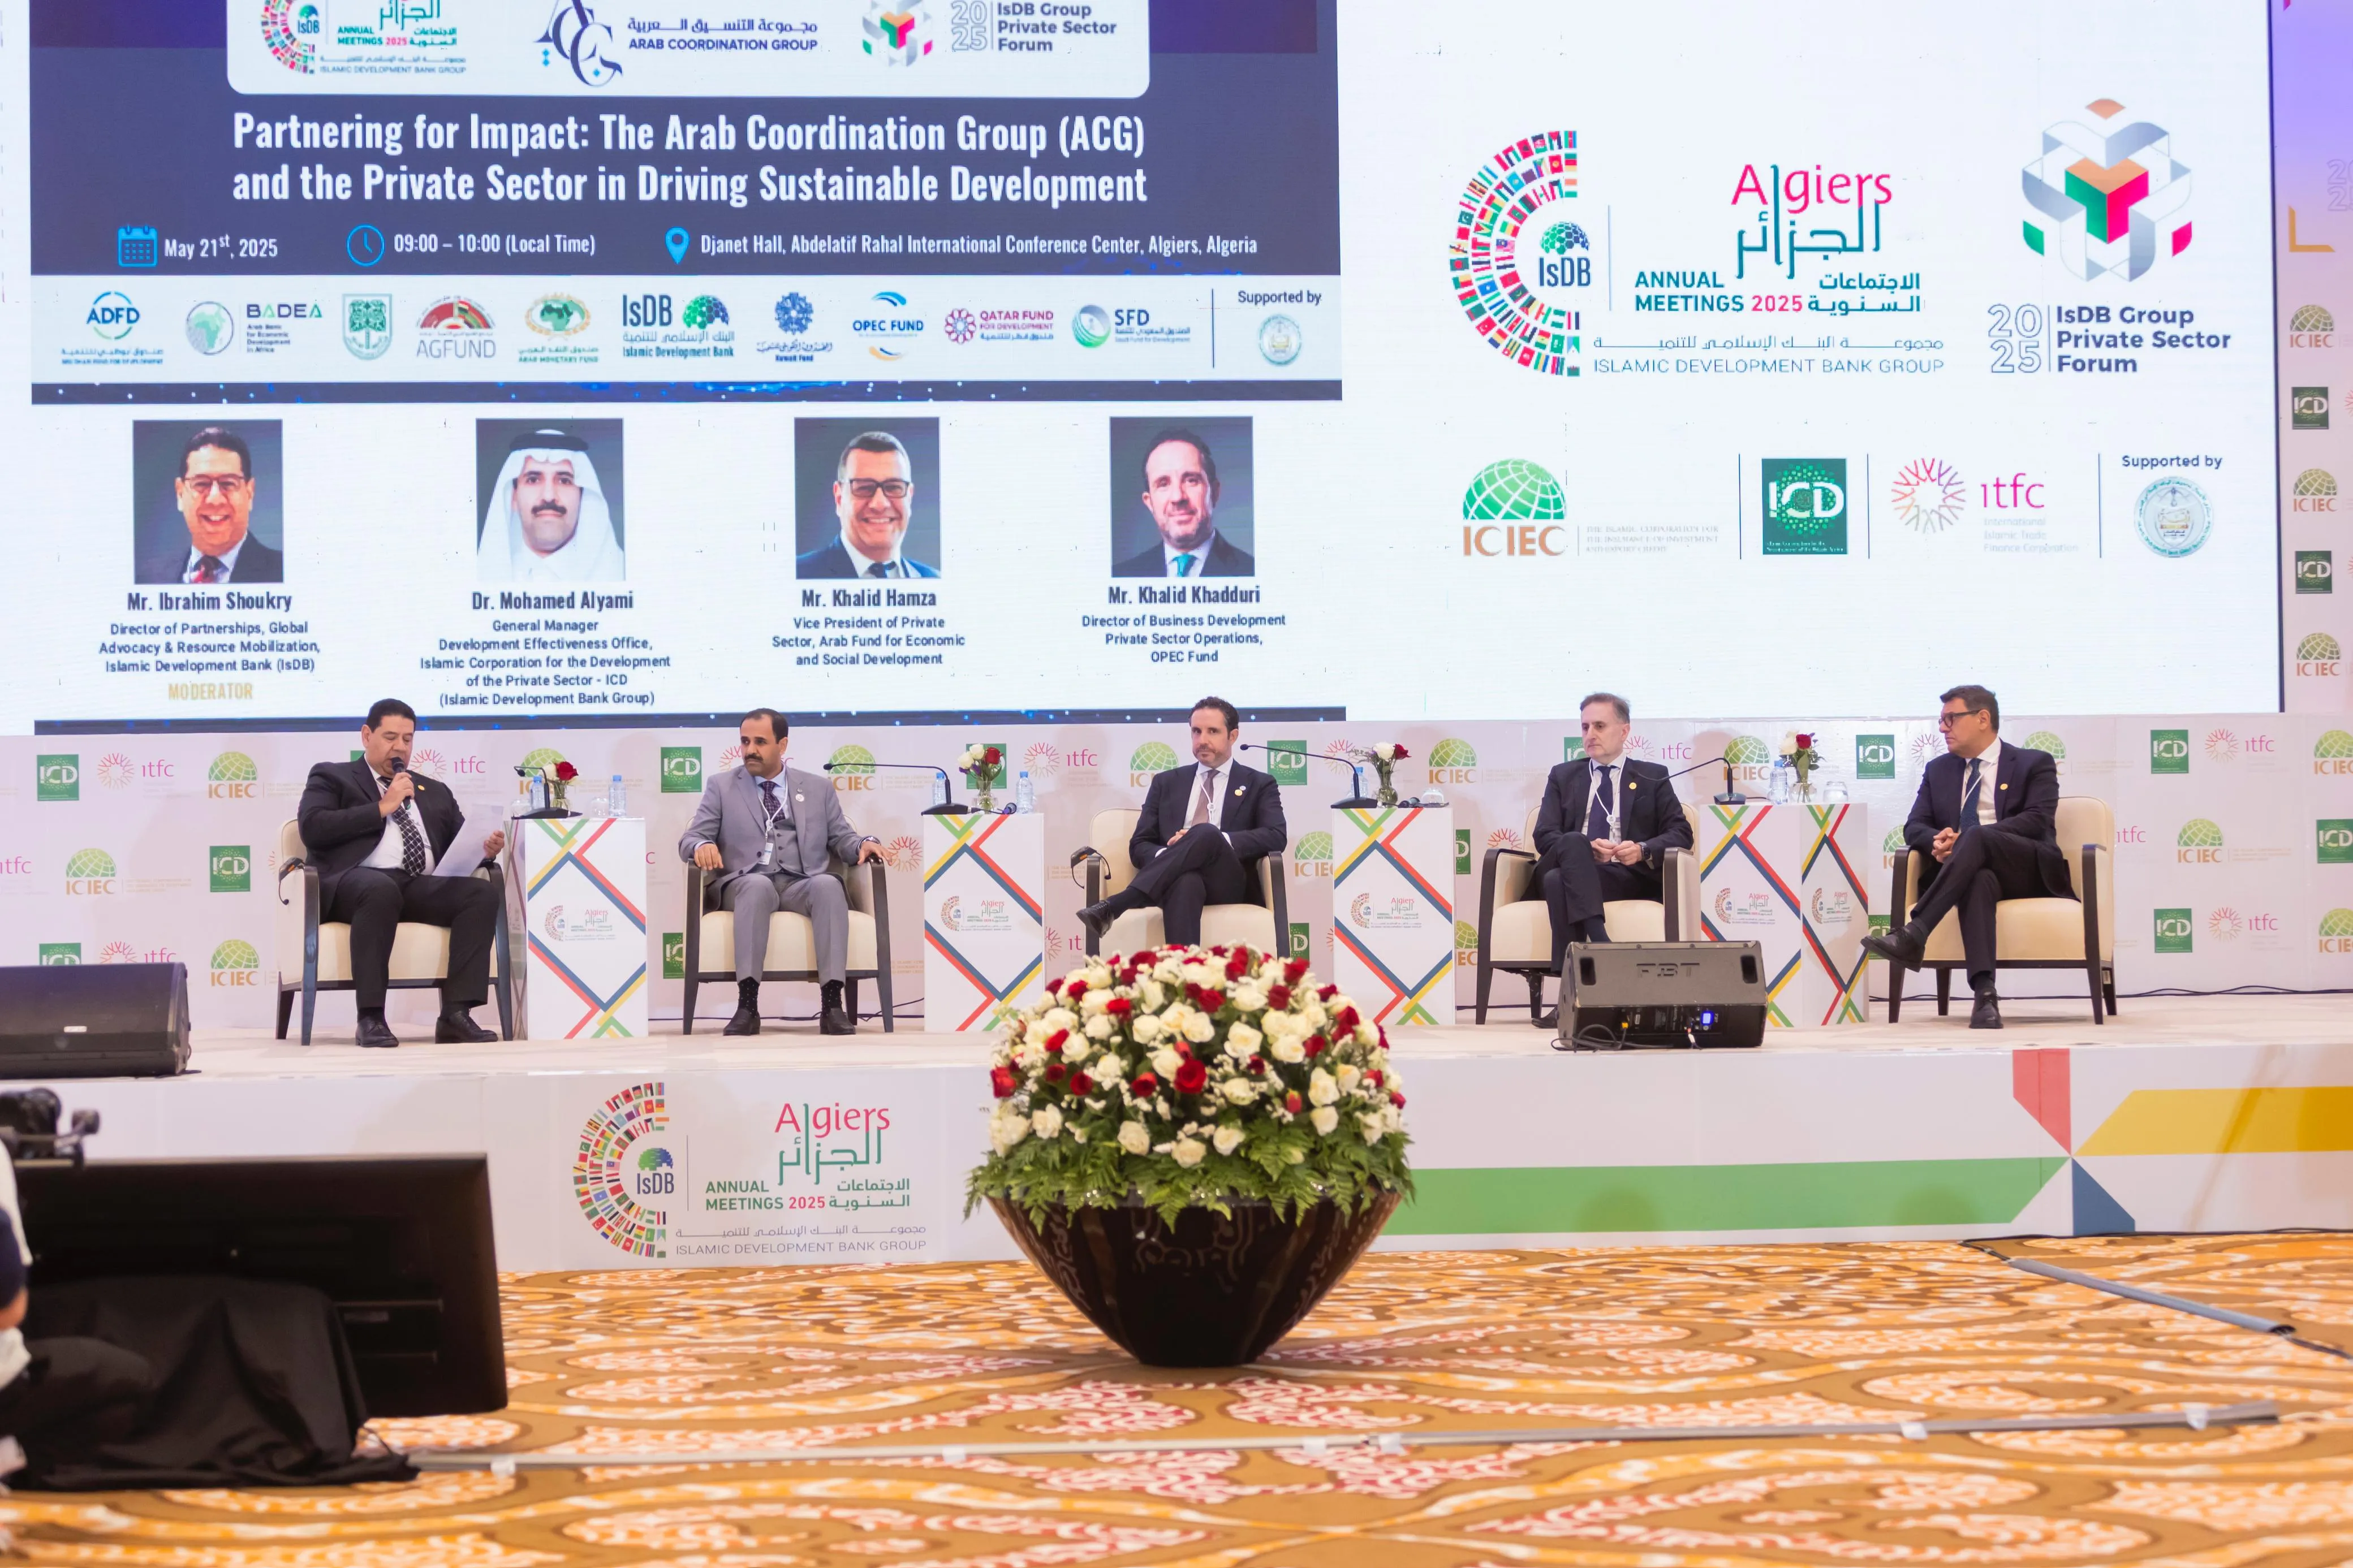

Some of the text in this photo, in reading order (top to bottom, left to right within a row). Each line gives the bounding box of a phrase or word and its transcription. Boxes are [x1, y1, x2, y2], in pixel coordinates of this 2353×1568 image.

[998, 2, 1092, 19] IsDB Group
[998, 19, 1117, 34] Private Sector
[630, 39, 818, 51] ARAB COORDINATION GROUP
[998, 38, 1053, 51] Forum
[234, 113, 1144, 158] Partnering for Impact: The Arab Coordination Group (ACG)
[233, 164, 1147, 209] and the Private Sector in Driving Sustainable Development
[1731, 165, 1891, 217] Algiers
[165, 239, 195, 260] May
[240, 239, 277, 257] 2025
[394, 234, 595, 256] 09:00 10:00 (Local Time)
[701, 235, 1257, 257] Djanet Hall, Abdelatif Rahal International Conference Center, Algiers, Algeria
[1540, 257, 1591, 287] IsDB
[1635, 271, 1724, 288] ANNUAL
[1820, 273, 1920, 290] الاجتماعات
[1238, 290, 1321, 306] Supported by
[1636, 295, 1802, 312] MEETINGS 2025
[1808, 295, 1920, 316] السنوية
[87, 308, 140, 324] ADFD
[247, 304, 322, 318] BADEA
[623, 295, 672, 326] IsDB
[980, 311, 1053, 321] QATAR FUND
[1115, 309, 1149, 326] SFD
[2057, 306, 2193, 329] IsDB Group
[853, 320, 924, 331] OPEC FUND
[1988, 304, 2042, 338] 20
[2058, 329, 2230, 348] Private Sector
[417, 340, 496, 358] AGFUND
[623, 346, 733, 359] Islamic Development Bank
[1990, 339, 2041, 373] 25
[1594, 359, 1943, 373] ISLAMIC DEVELOPMENT BANK GROUP
[2058, 355, 2137, 372] Forum
[2122, 455, 2222, 470] Supported by
[1981, 473, 2044, 508] itfc
[1769, 481, 1844, 518] ICD
[128, 591, 292, 612] Mr. Ibrahim Shoukry
[473, 591, 633, 612] Dr. Mohamed Alyami
[802, 589, 936, 607] Mr. Khalid Hamza
[1109, 586, 1260, 604] Mr. Khalid Khadduri
[111, 621, 308, 636] Director of Partnerships, Global
[794, 616, 945, 629] Vice President of Private
[1082, 614, 1285, 628] Director of Business Development
[99, 640, 320, 656] Advocacy & Resource Mobilization,
[773, 634, 965, 649] Sector, Arab Fund for Economic
[1106, 632, 1262, 647] Private Sector Operations,
[796, 653, 942, 667] and Social Development
[1152, 650, 1218, 662] OPEC Fund
[106, 658, 314, 674] Islamic Development Bank (IsDB)
[169, 683, 252, 701] MODERATOR
[2153, 740, 2187, 758] ICD
[2246, 735, 2274, 752] itfc
[1859, 745, 1893, 762] ICD
[142, 759, 173, 777] itfc
[454, 756, 485, 773] itfc
[40, 766, 77, 783] ICD
[775, 1103, 890, 1141] Algiers
[637, 1173, 674, 1194] IsDB
[706, 1181, 769, 1193] ANNUAL
[838, 1178, 909, 1191] الاجتماعات
[706, 1196, 825, 1210] MEETINGS 2025
[829, 1195, 910, 1211] السنوية
[676, 1241, 926, 1255] ISLAMIC DEVELOPMENT BANK GROUP
